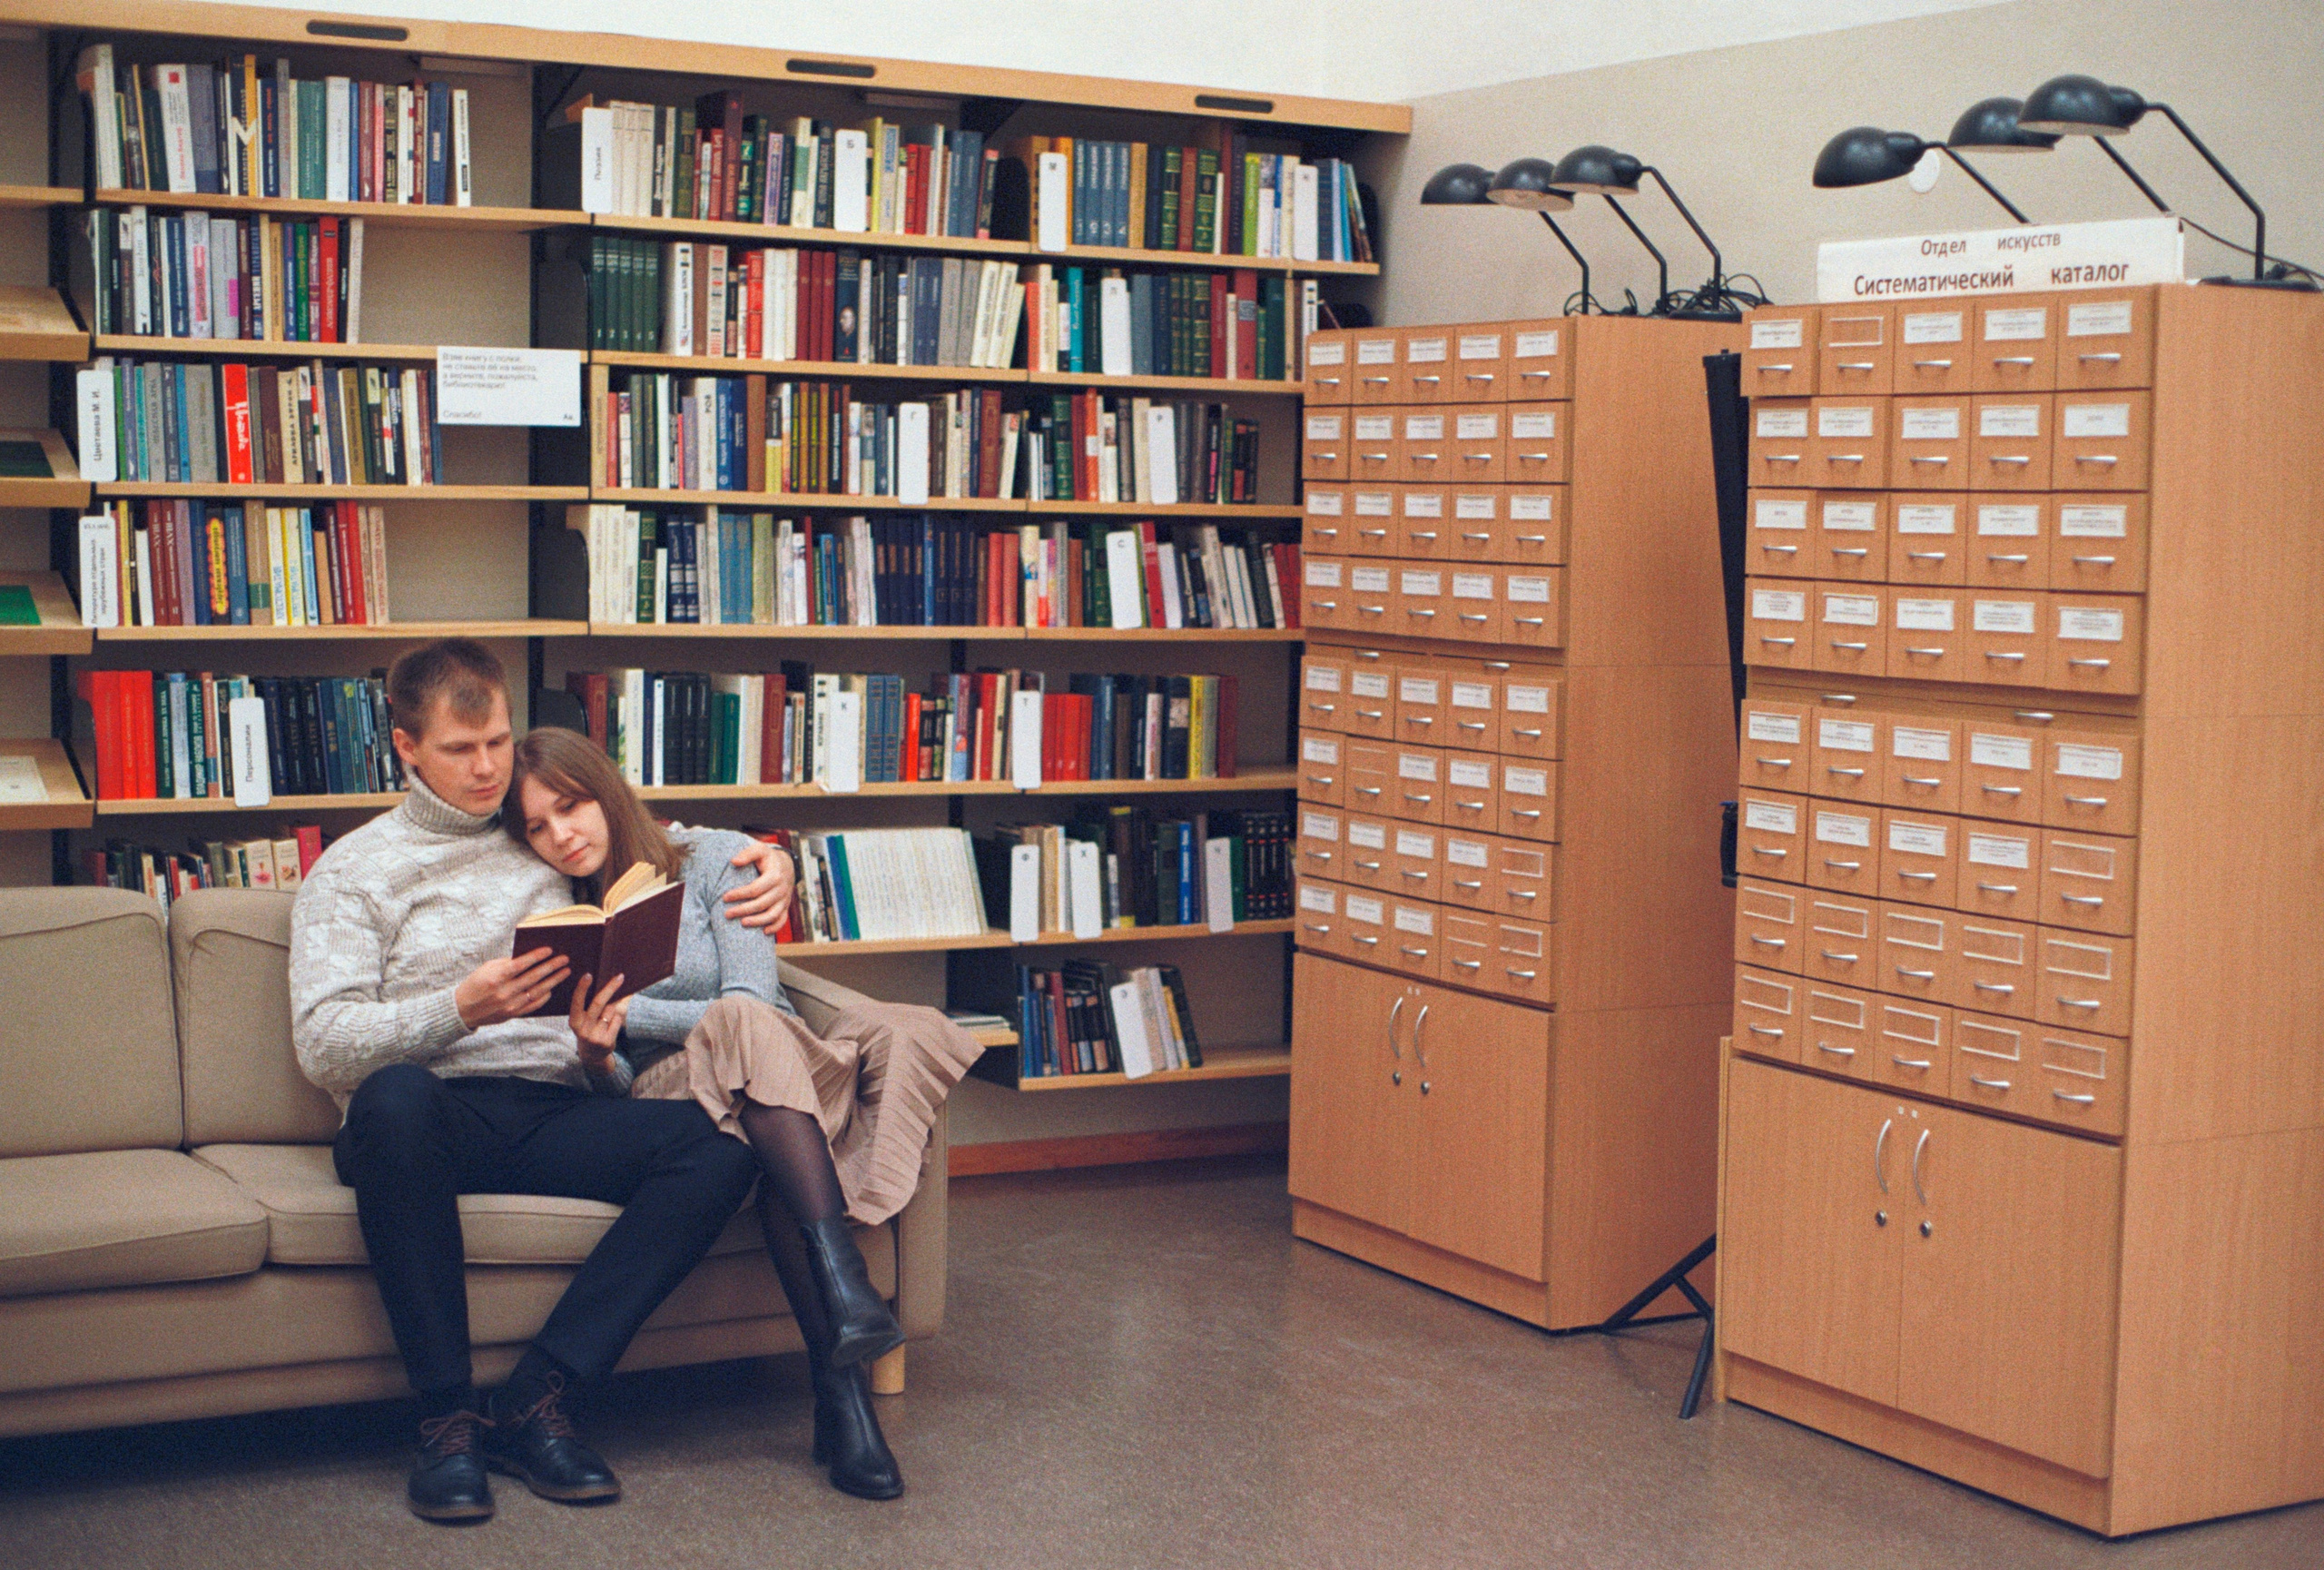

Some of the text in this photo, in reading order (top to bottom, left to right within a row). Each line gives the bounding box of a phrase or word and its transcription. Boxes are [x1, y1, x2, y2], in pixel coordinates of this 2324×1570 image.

[1920, 232, 2062, 259] Отдел искусств
[1854, 262, 2130, 296] Систематический каталог
[93, 414, 103, 462] Цветаева
[244, 724, 253, 783] Персоналии
